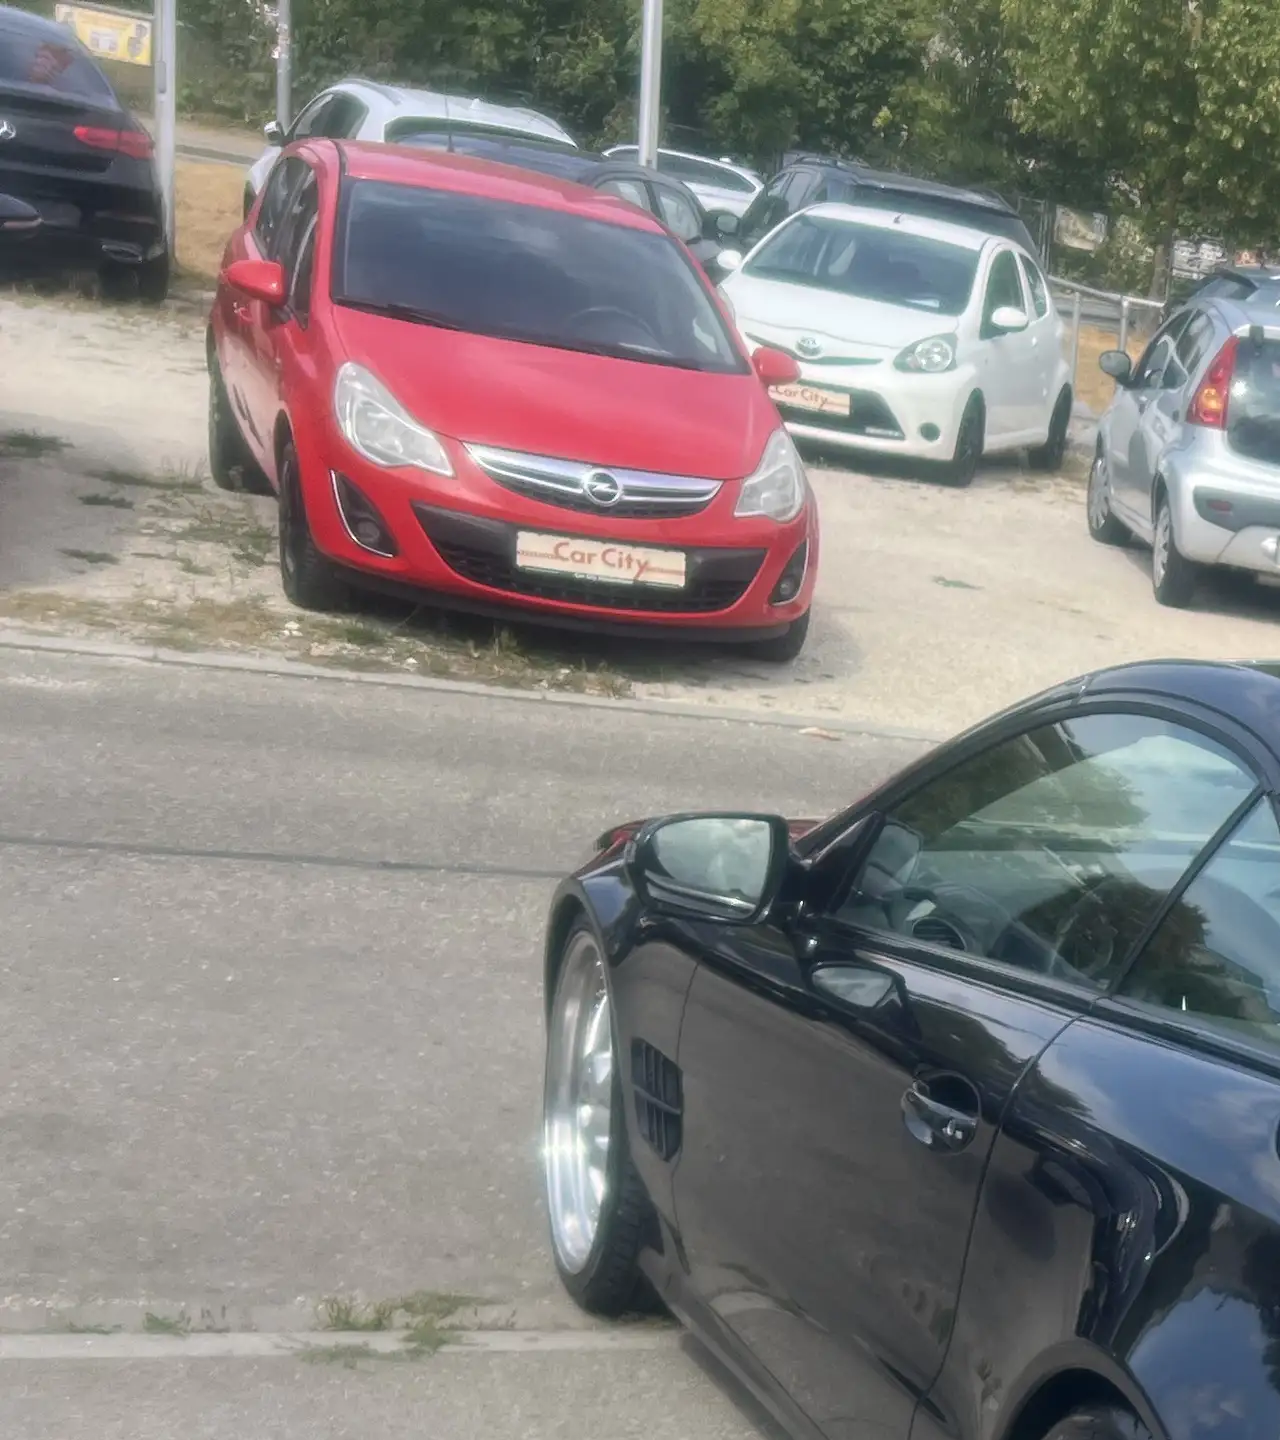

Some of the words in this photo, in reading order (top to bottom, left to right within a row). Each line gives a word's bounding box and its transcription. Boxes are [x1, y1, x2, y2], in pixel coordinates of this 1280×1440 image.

[800, 388, 828, 410] City
[553, 541, 598, 565] Car
[601, 547, 649, 581] City
